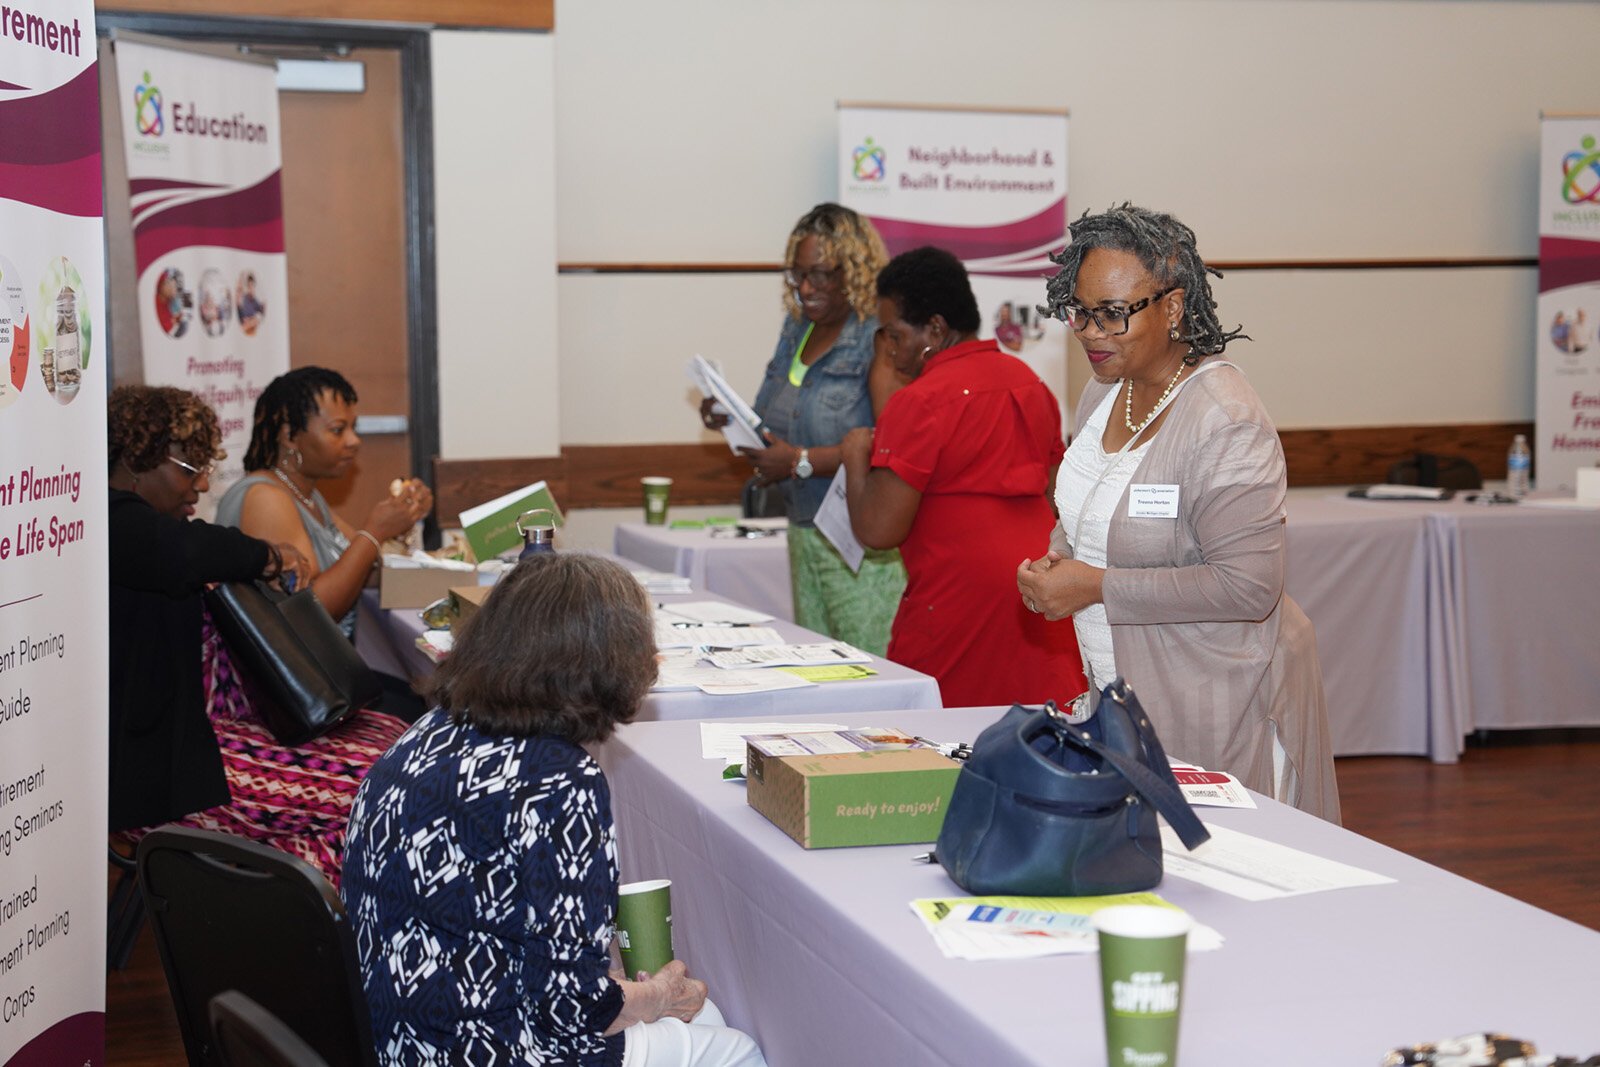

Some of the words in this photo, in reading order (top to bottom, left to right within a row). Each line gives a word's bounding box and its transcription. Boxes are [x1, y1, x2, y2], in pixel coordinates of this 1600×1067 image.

[172, 102, 268, 143] Education
[908, 147, 1038, 169] Neighborhood
[1043, 150, 1054, 167] &
[899, 172, 939, 190] Built
[944, 173, 1055, 193] Environment
[20, 464, 81, 504] Planning
[16, 517, 45, 556] Life
[48, 515, 84, 557] Span
[20, 633, 65, 665] Planning
[14, 800, 64, 842] Seminars
[836, 802, 877, 820] Ready
[881, 802, 896, 815] to
[898, 796, 941, 817] enjoy!
[27, 909, 70, 955] Planning
[3, 985, 36, 1024] Corps
